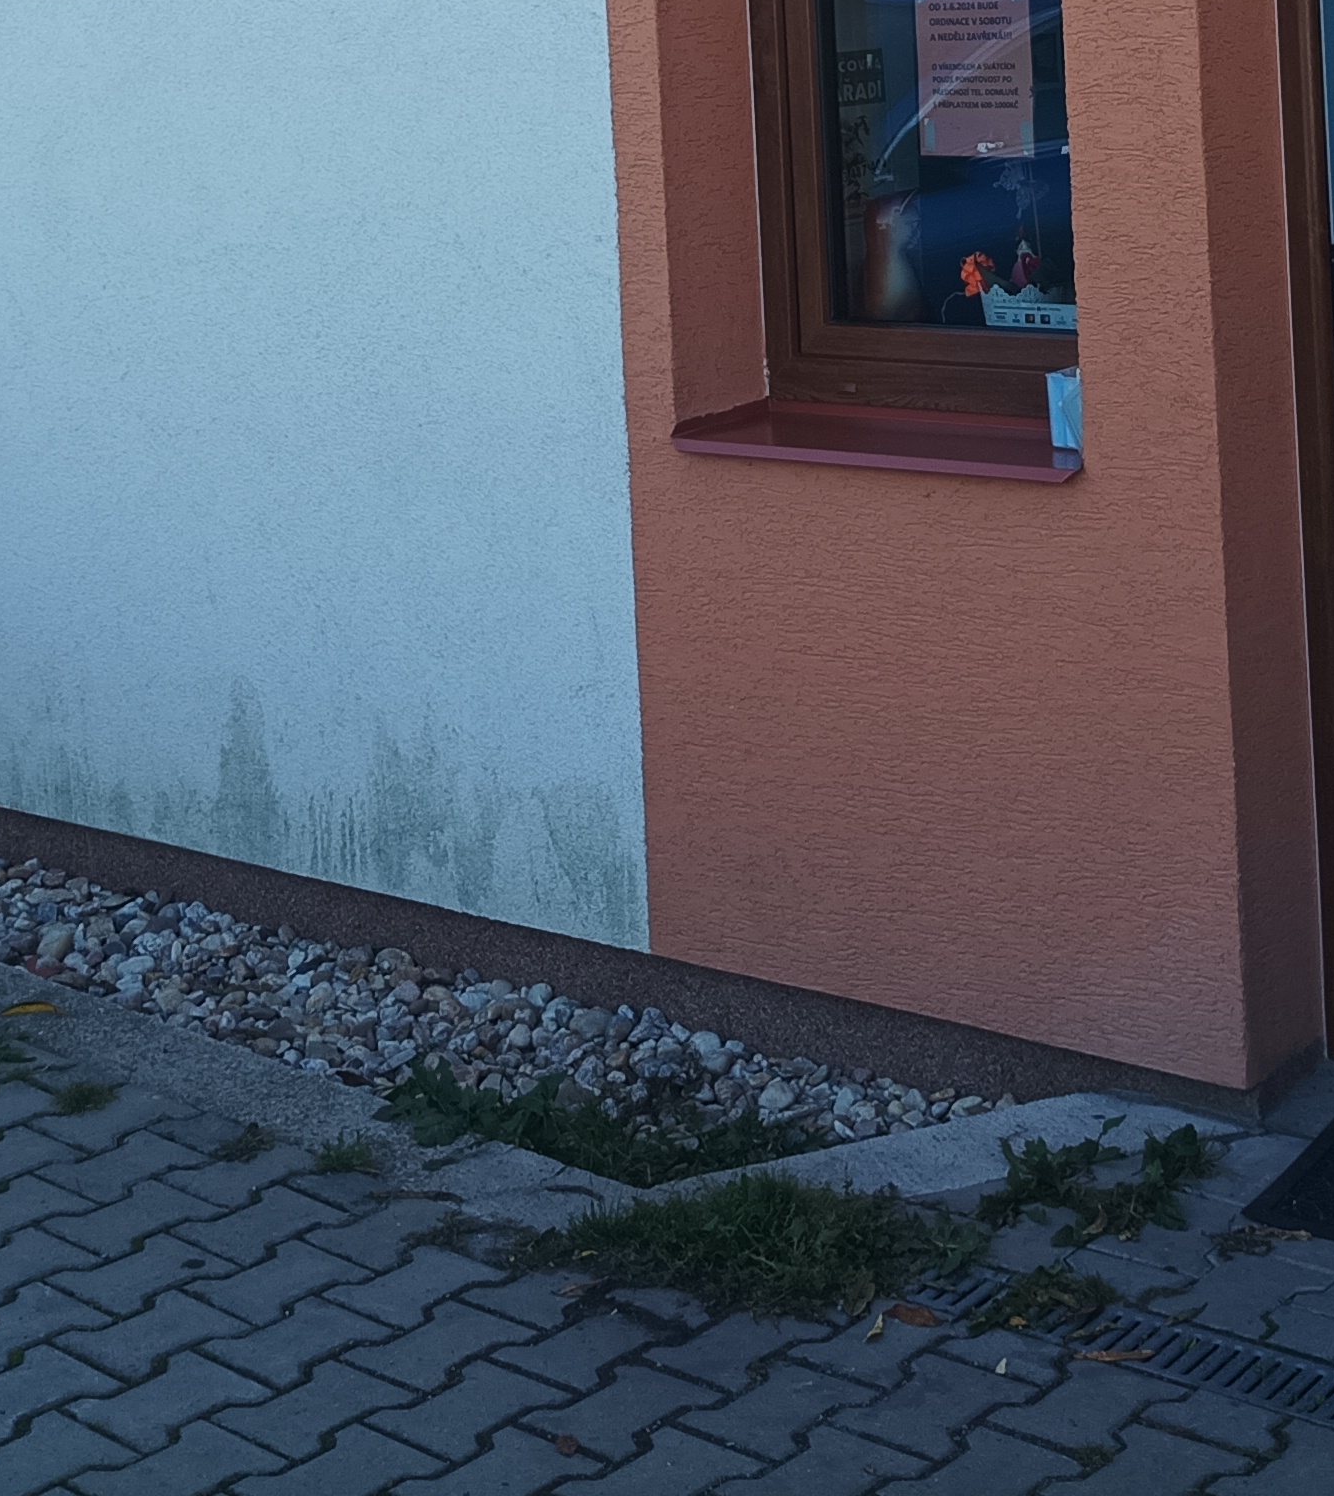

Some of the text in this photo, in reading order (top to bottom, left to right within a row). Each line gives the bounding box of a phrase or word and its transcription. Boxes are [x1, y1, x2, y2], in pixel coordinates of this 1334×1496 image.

[928, 2, 941, 12] OD
[977, 0, 999, 10] BUDE
[929, 16, 1012, 26] ORDINACE V SOBOTU
[929, 33, 937, 42] A
[937, 31, 966, 42] NEDĚLI
[837, 56, 882, 73] ČOVA
